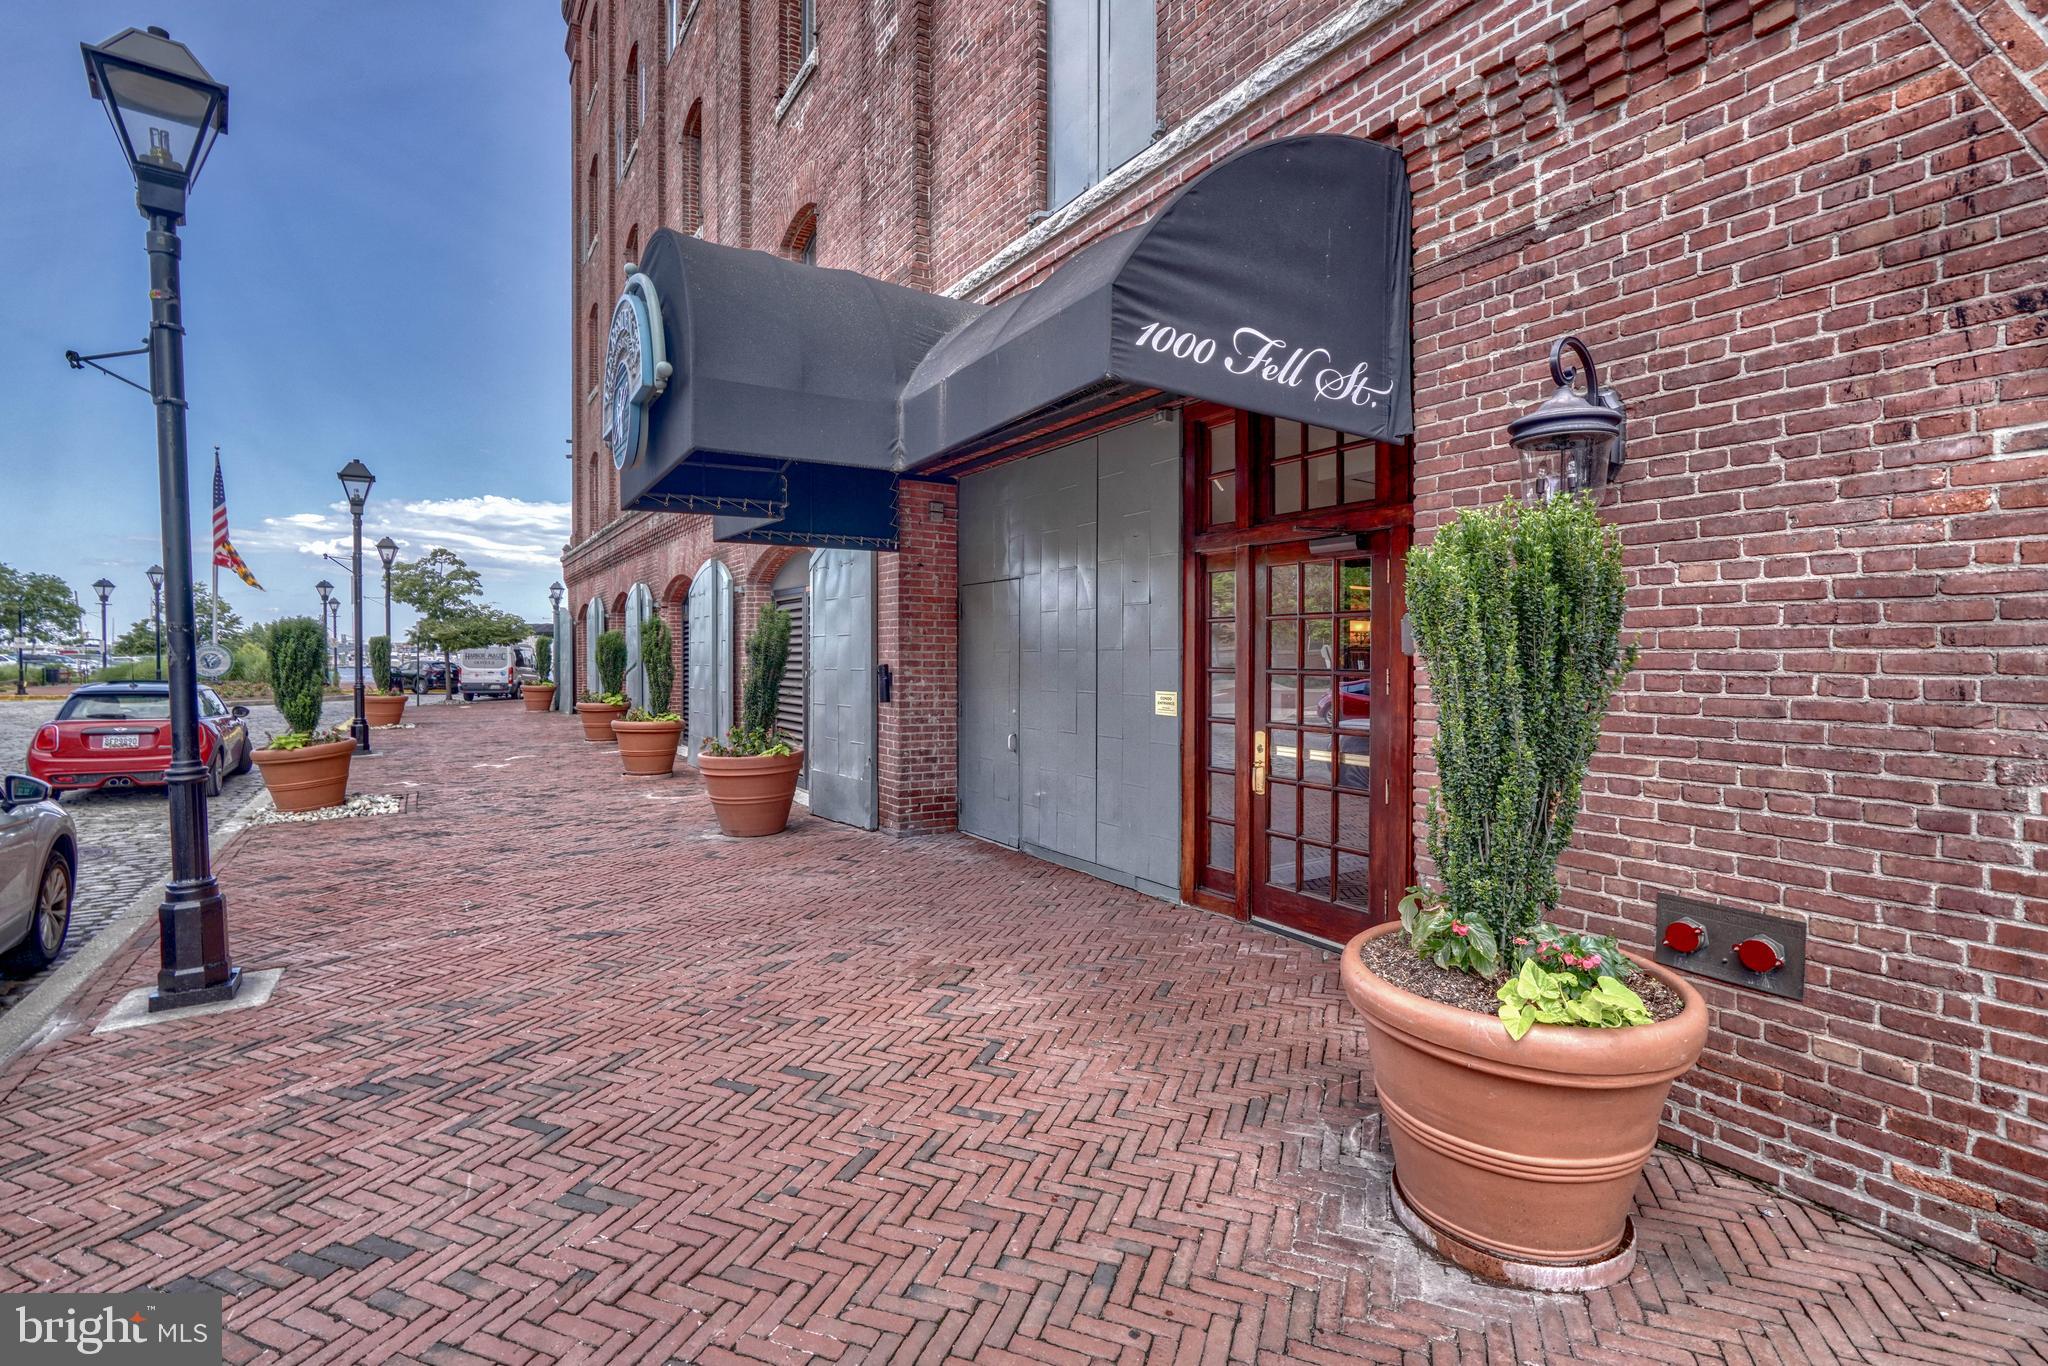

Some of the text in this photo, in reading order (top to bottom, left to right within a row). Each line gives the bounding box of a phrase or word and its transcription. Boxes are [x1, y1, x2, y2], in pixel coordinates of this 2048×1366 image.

[1135, 322, 1393, 408] 1000 Fell St.
